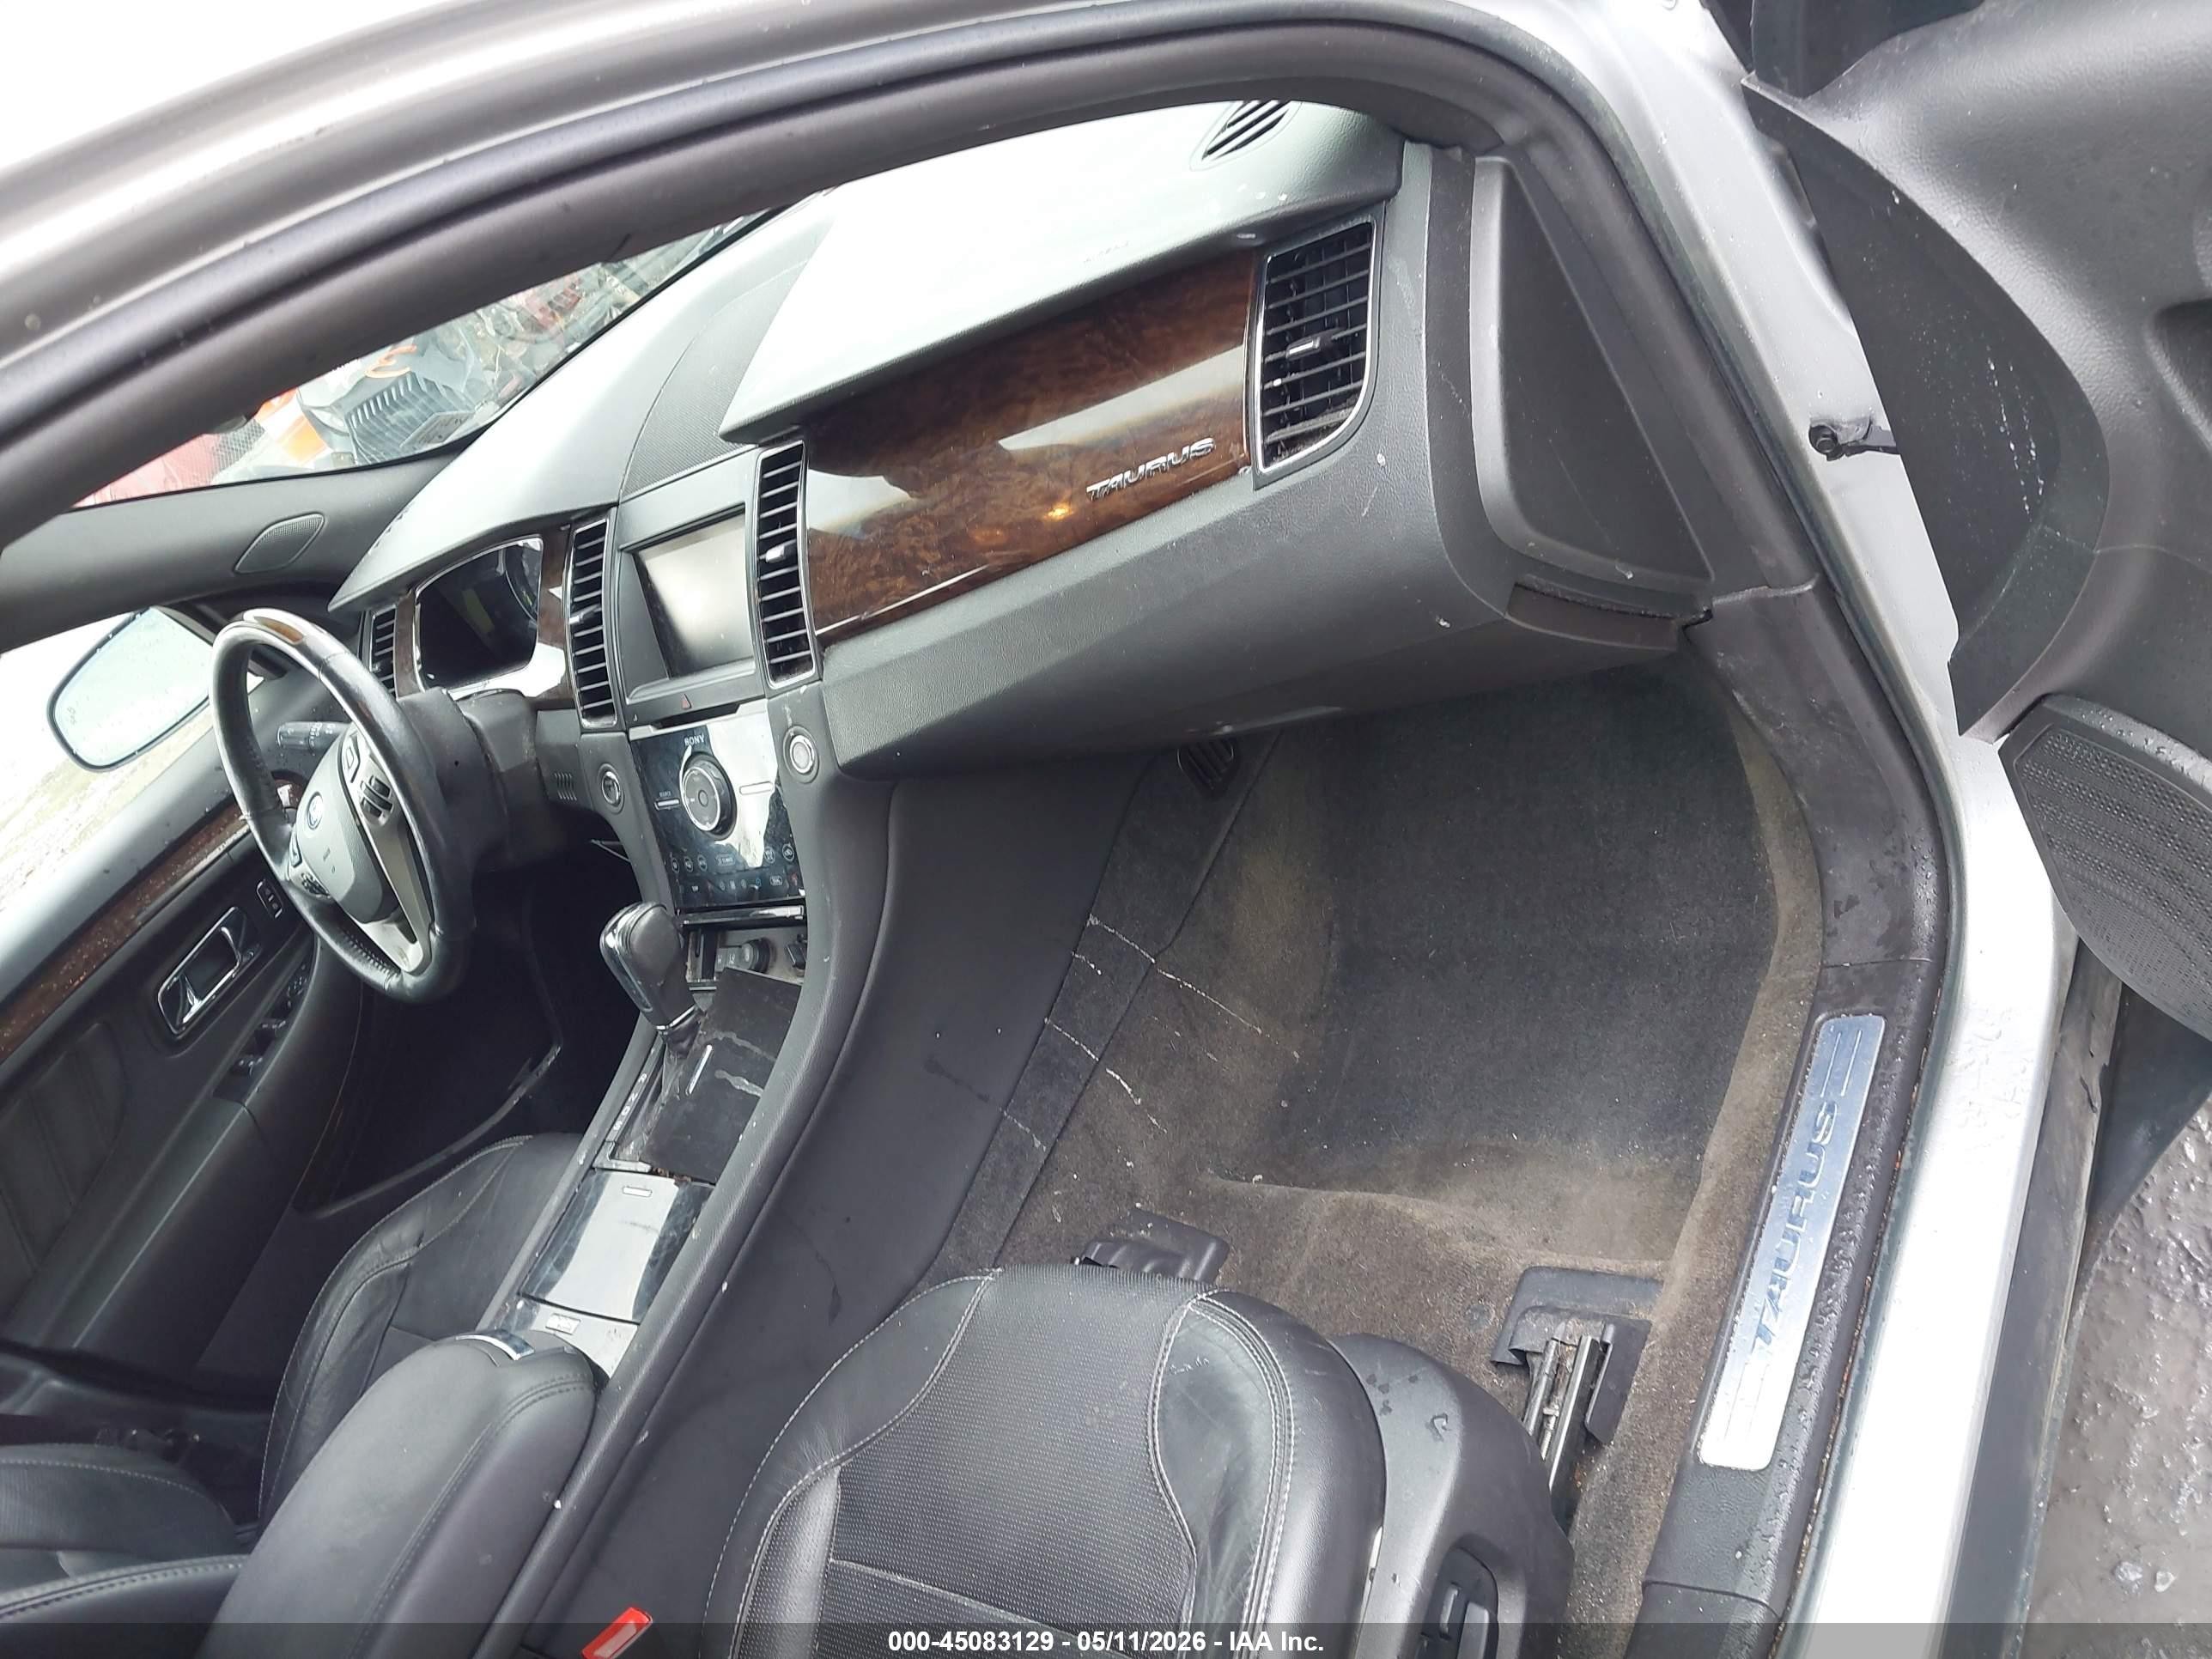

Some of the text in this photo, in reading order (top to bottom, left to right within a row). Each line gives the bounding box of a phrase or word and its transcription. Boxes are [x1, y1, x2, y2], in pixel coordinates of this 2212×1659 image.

[1086, 437, 1216, 501] TAURUS
[628, 1092, 639, 1102] N
[1750, 1100, 1838, 1354] TAURUS
